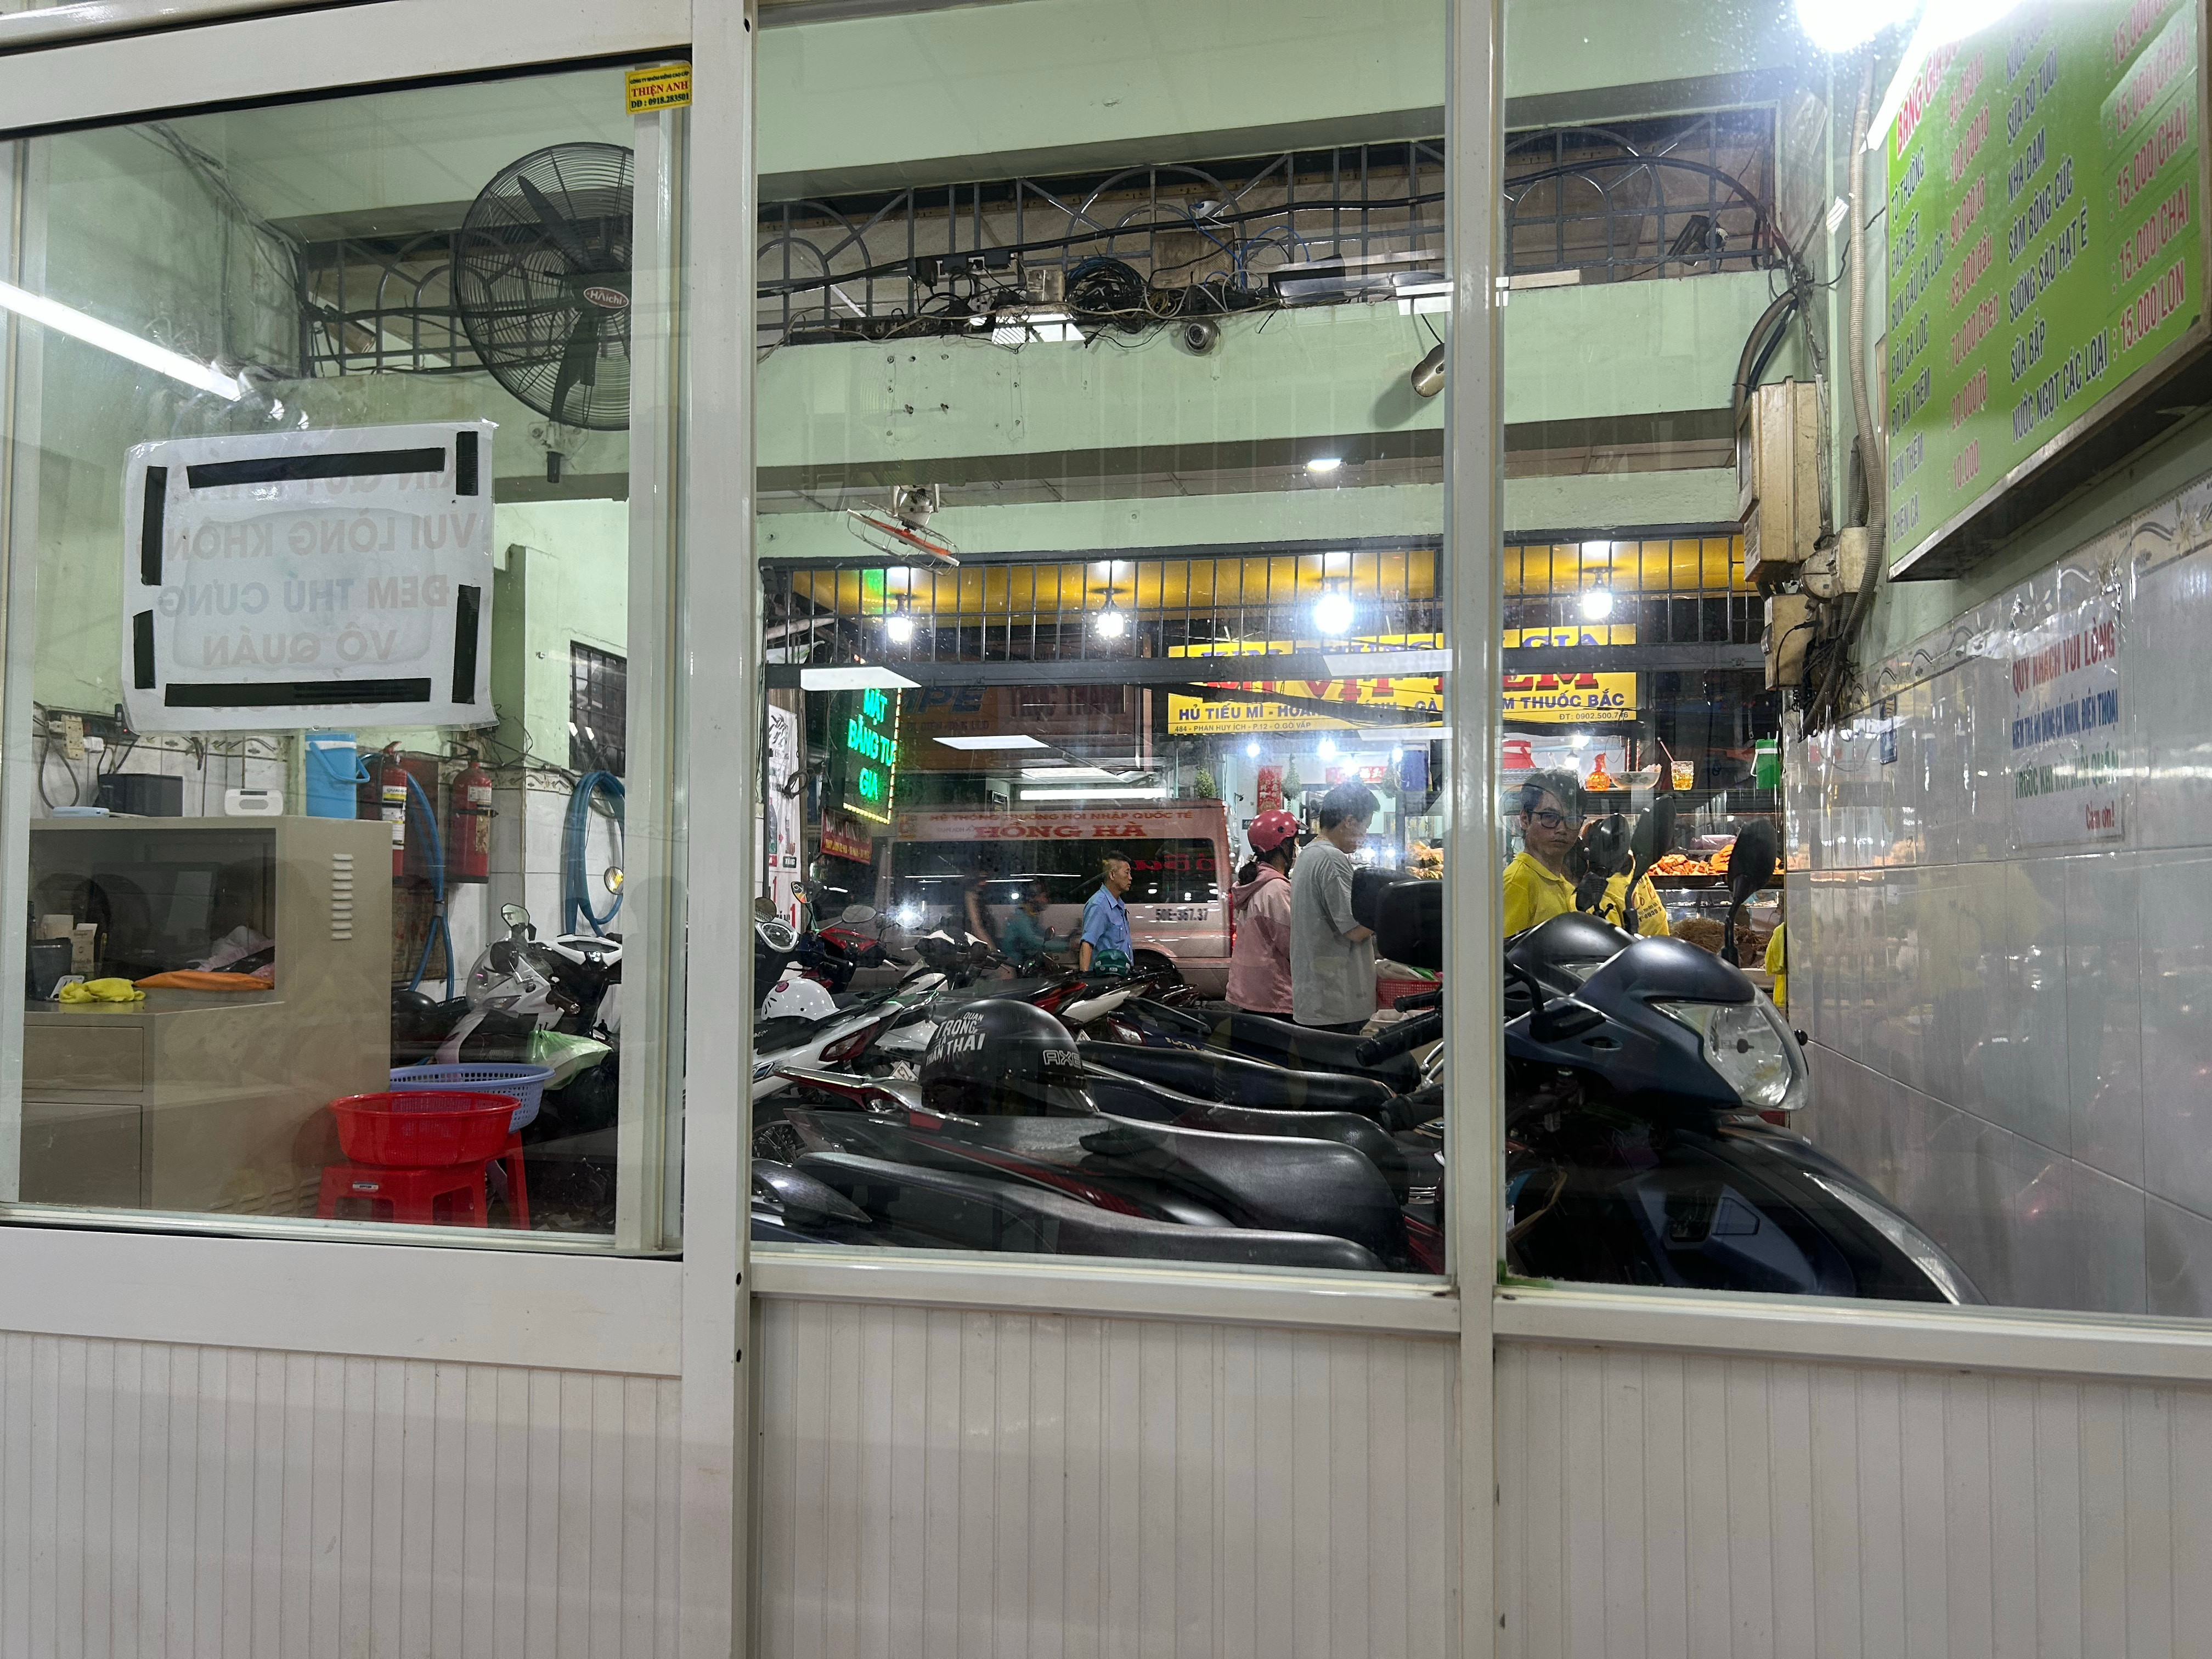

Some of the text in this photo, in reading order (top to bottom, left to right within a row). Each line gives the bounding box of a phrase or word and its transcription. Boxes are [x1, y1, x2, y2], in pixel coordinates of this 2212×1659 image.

[631, 81, 688, 97] THIỆN ANH
[2007, 97, 2022, 145] SỮA
[2025, 70, 2036, 120] BÒ
[1900, 145, 1924, 210] THƯỜNG
[2008, 126, 2045, 205] NHA ĐAM
[2117, 100, 2187, 210] 15.000/CHAI
[1905, 211, 1919, 259] BIỆT
[1951, 172, 1985, 250] 90.000/tô
[2008, 154, 2073, 264] SÂM BÔNG CÚC
[2119, 181, 2190, 284] 15.000/CHAI
[1892, 228, 1943, 332] BÚN ĐẦU CÁ LÓC
[1951, 225, 1993, 310] 85.000/đầu
[2010, 266, 2035, 323] SƯƠNG
[2039, 240, 2055, 292] SÁO
[2059, 219, 2076, 272] HẠT
[1892, 311, 1928, 385] ĐẦU CÁ LÓC
[1951, 288, 1999, 370] 70.000/Chén
[2011, 309, 2045, 383] SỮA BẮP
[2012, 391, 2034, 443] NƯỚC
[2036, 371, 2059, 423] NGỌT
[2063, 347, 2081, 400] CÁC
[2085, 329, 2108, 382] LOẠI
[2120, 259, 2185, 351] 15.000/LON
[1892, 365, 1931, 437] ĐỒ ĂN THÊM
[1951, 365, 1987, 431] 20.000/tô
[1892, 431, 1923, 490] BÚN THÊM
[1954, 439, 1979, 490] 10.000
[1892, 498, 1908, 543] CHÉN
[2063, 633, 2080, 674] VUI
[2084, 617, 2115, 667] LÒNG
[1178, 704, 1201, 721] HỦ
[1205, 703, 1241, 720] TIẾU
[1246, 704, 1263, 718] MÌ
[1520, 690, 1582, 709] THUỐC
[1587, 687, 1625, 707] BẮC
[1194, 724, 1214, 732] PHAN
[1233, 721, 1246, 731] ÍCH
[1296, 719, 1311, 729] VẤP
[2097, 688, 2119, 731] THOẠI
[2039, 764, 2053, 795] KHI
[1092, 821, 1147, 837] HÀ
[962, 1012, 984, 1022] QUAN
[1042, 1049, 1083, 1070] AXE
